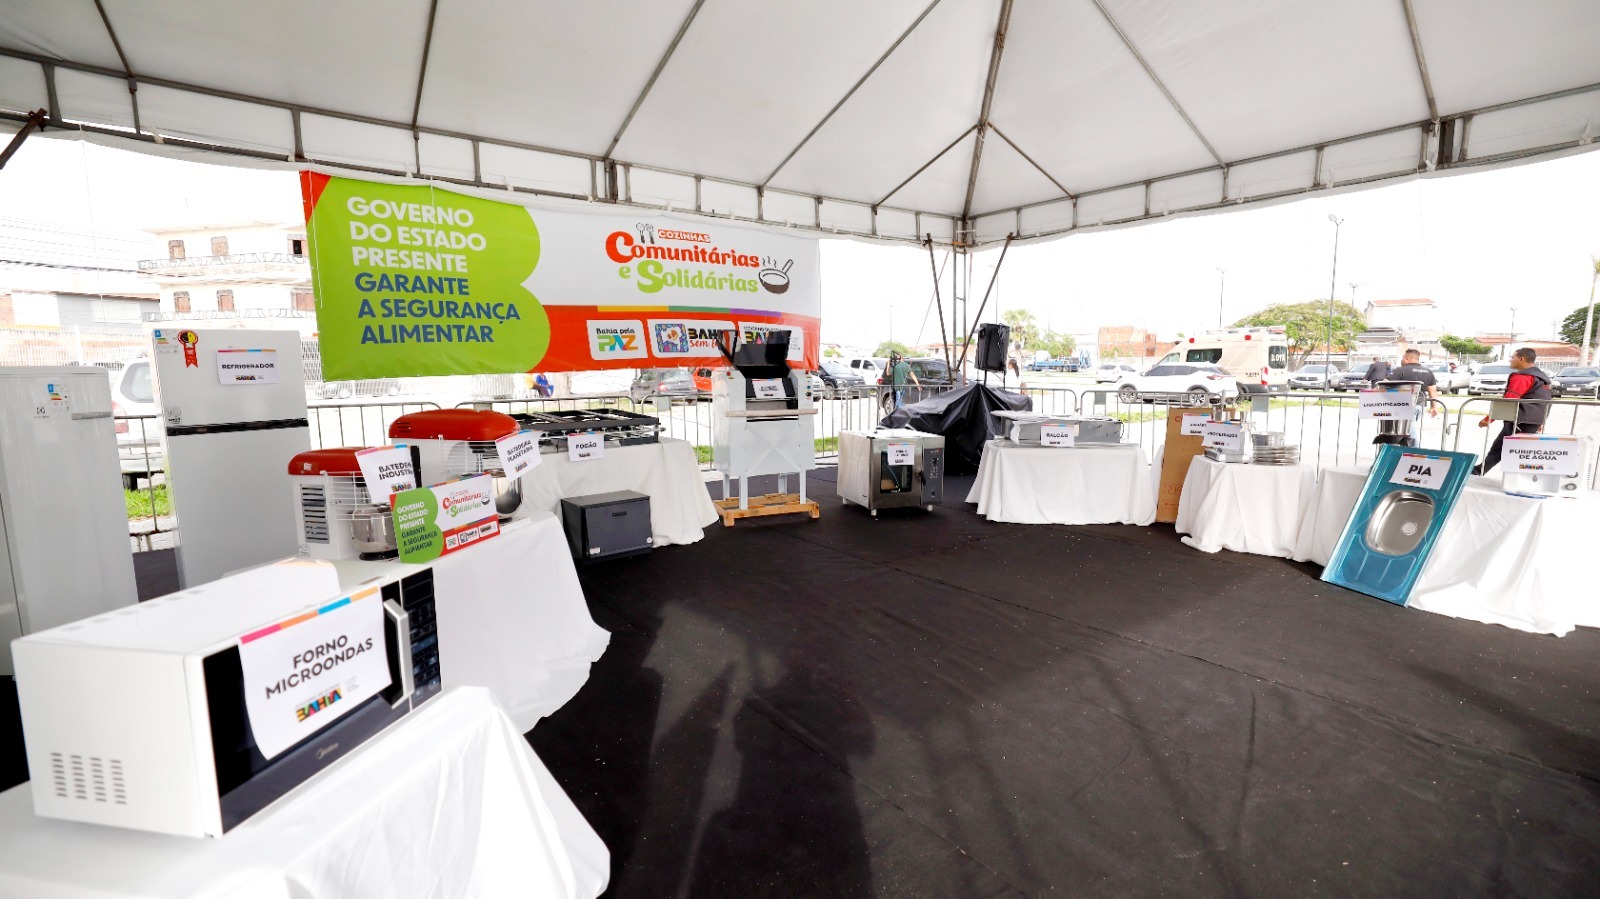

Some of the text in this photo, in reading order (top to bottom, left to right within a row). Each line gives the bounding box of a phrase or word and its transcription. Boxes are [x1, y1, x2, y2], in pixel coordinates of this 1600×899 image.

[347, 196, 474, 228] GOVERNO
[349, 221, 487, 251] DO ESTADO
[605, 231, 760, 268] Comunitárias
[658, 230, 711, 243] COZINHAS
[352, 246, 468, 273] PRESENTE
[355, 272, 470, 296] GARANTE
[618, 260, 759, 294] e Solidárias
[358, 299, 521, 324] A SEGURANÇA
[361, 325, 494, 344] ALIMENTAR
[597, 335, 638, 351] PAZ
[1408, 464, 1432, 476] PIA
[293, 634, 348, 670] FORNO
[265, 637, 374, 699] MICROONDAS
[296, 688, 342, 723] BAHIA
